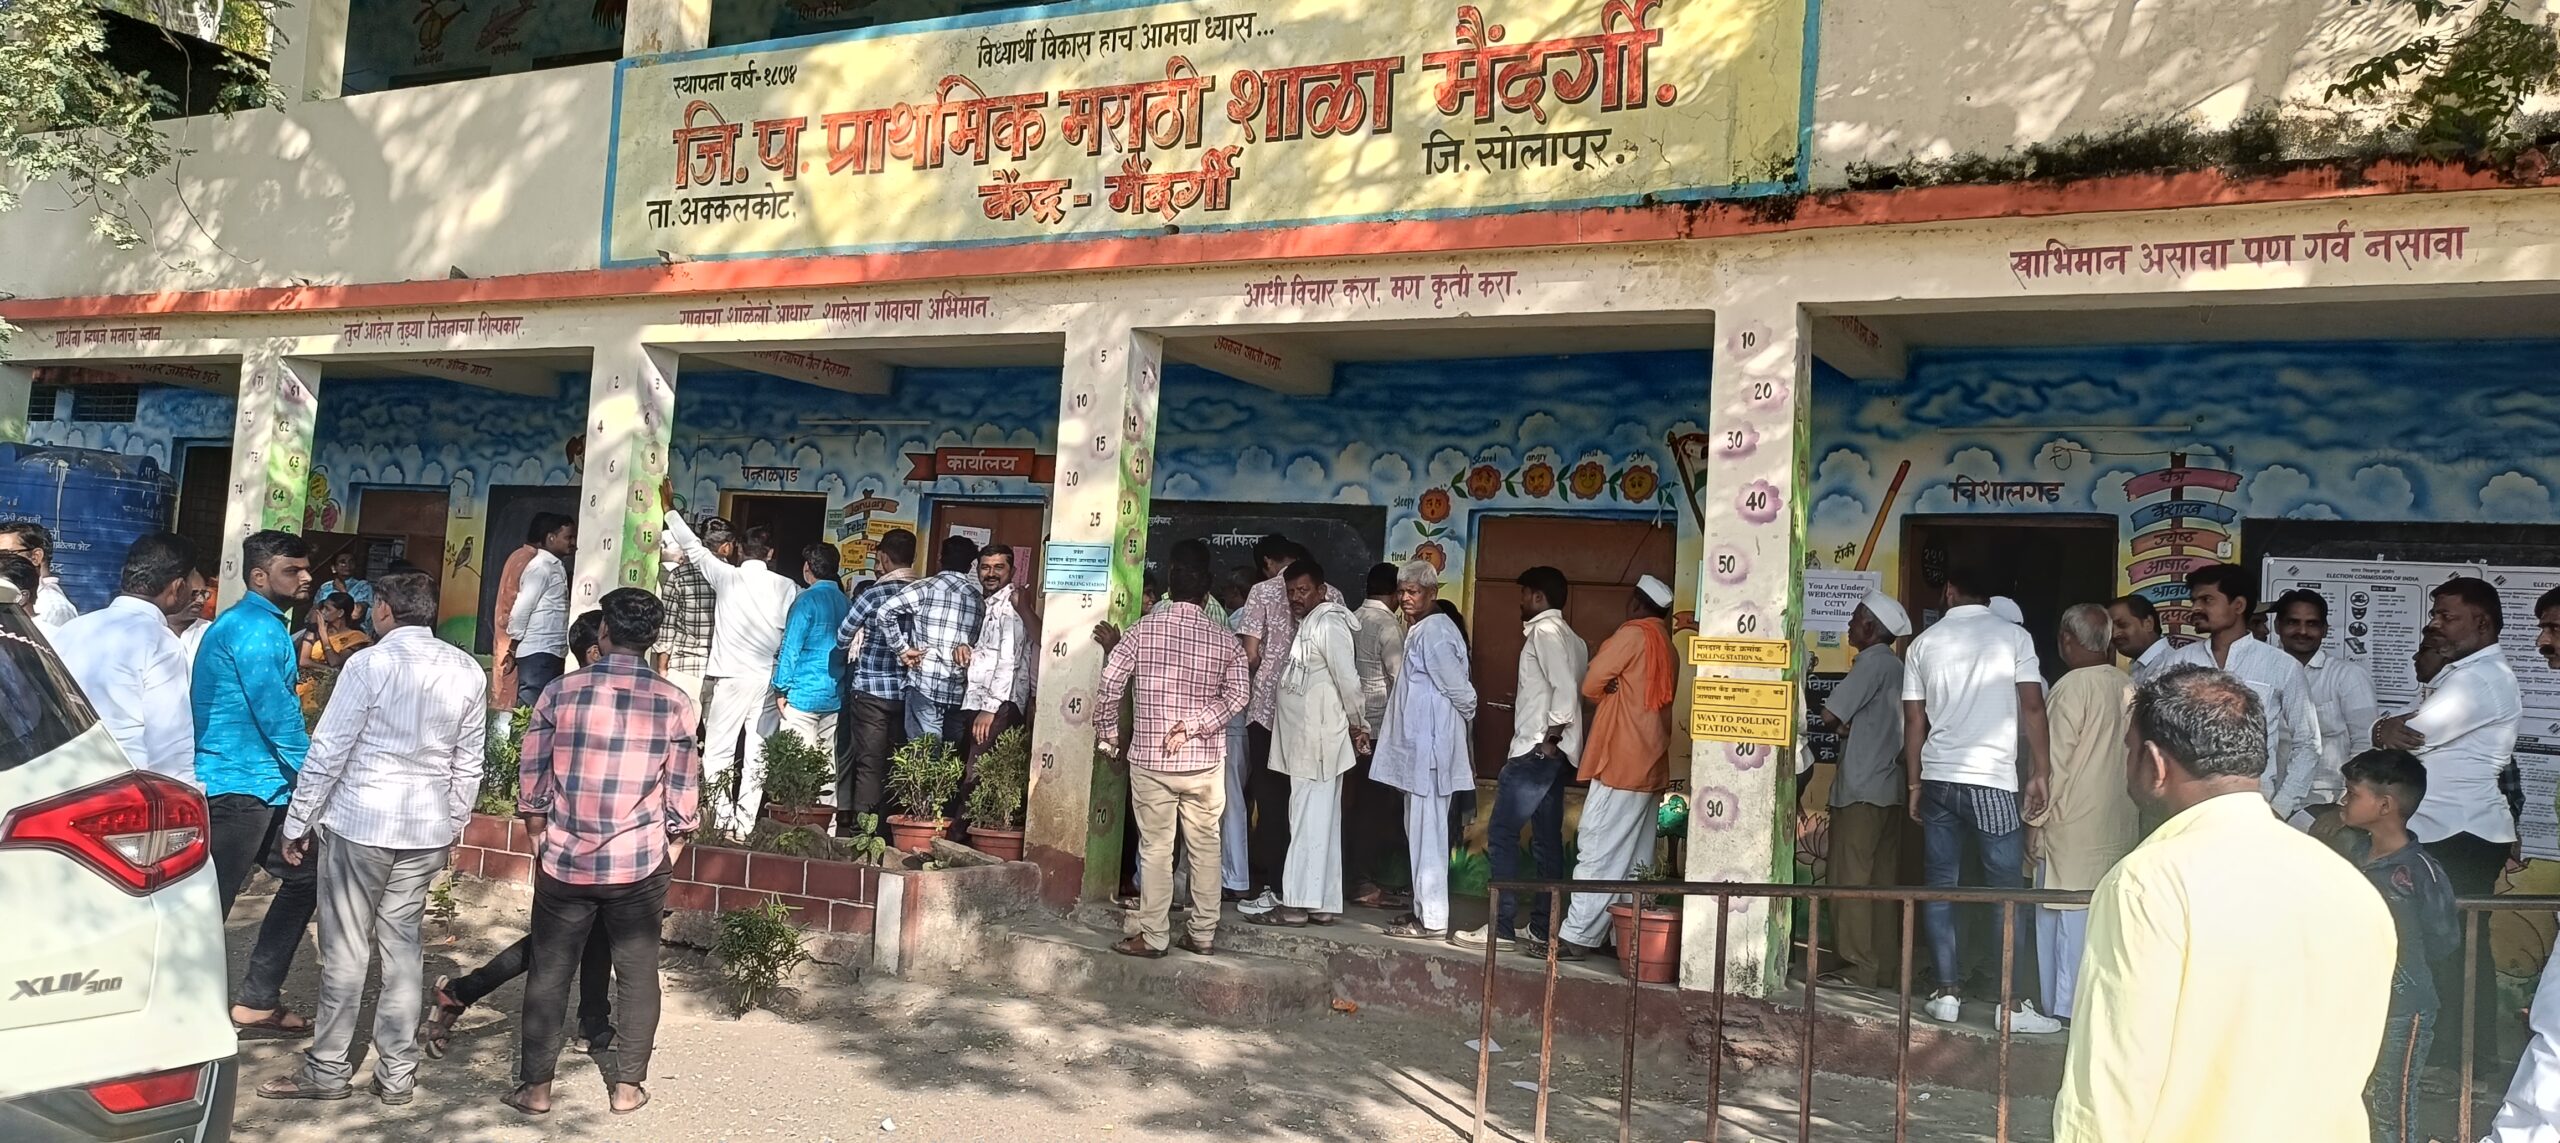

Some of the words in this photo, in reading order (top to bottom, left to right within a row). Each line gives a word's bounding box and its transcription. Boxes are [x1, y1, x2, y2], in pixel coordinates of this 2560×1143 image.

[1041, 28, 1095, 62] विकास
[1099, 25, 1137, 58] हाच
[1141, 19, 1200, 50] आमचा
[673, 71, 729, 98] स्थापना
[821, 74, 1048, 175] प्राथमिक
[1058, 55, 1216, 156] मराठी
[1227, 56, 1405, 144] शाळा
[2139, 239, 2235, 279] असावा
[2241, 234, 2296, 268] पण
[2303, 219, 2355, 263] गर्व
[2363, 226, 2470, 271] नसावा
[1244, 275, 1287, 308] आधी
[1291, 274, 1338, 308] विचार
[1390, 275, 1425, 301] मग
[1431, 265, 1473, 309] कृती
[823, 295, 872, 333] शाळेला
[1741, 332, 1755, 349] 10
[1101, 351, 1107, 362] 5
[614, 377, 619, 389] 2
[1142, 371, 1147, 384] 7
[291, 385, 300, 396] 61
[1754, 383, 1772, 400] 20
[1077, 394, 1087, 406] 10
[645, 412, 650, 424] 6
[1128, 416, 1137, 432] 14
[279, 420, 290, 432] 62
[597, 420, 603, 433] 4
[1096, 436, 1106, 451] 15
[1727, 431, 1743, 449] 30
[289, 456, 299, 468] 63
[651, 453, 656, 465] 9
[946, 450, 1019, 472] कार्यालय
[1526, 452, 1547, 463] angry
[610, 459, 615, 472] 6
[1135, 459, 1144, 474] 21
[1066, 471, 1078, 486] 20
[273, 489, 285, 501] 64
[635, 489, 643, 501] 12
[1948, 474, 2065, 507] विशालगड
[590, 495, 596, 506] 8
[1123, 500, 1131, 515] 28
[1394, 495, 1414, 509] sleepy
[1746, 491, 1766, 511] 40
[1090, 513, 1101, 526] 25
[643, 531, 652, 542] 15
[1212, 528, 1268, 548] वार्ताफल
[603, 538, 611, 550] 10
[1128, 540, 1137, 554] 35
[1391, 550, 1407, 561] tired
[1718, 555, 1735, 573] 50
[629, 569, 637, 581] 18
[584, 583, 592, 596] 12
[1808, 591, 1863, 599] WEBCASTING
[1081, 593, 1092, 608] 35
[1115, 593, 1125, 607] 42
[1737, 614, 1756, 634] 60
[1053, 642, 1067, 657] 40
[1069, 698, 1082, 713] 45
[1697, 714, 1718, 722] WAY
[1720, 714, 1734, 723] TO
[1736, 716, 1780, 726] POLLING
[1696, 724, 1738, 733] STATION
[1041, 754, 1053, 769] 50
[1706, 800, 1723, 817] 90
